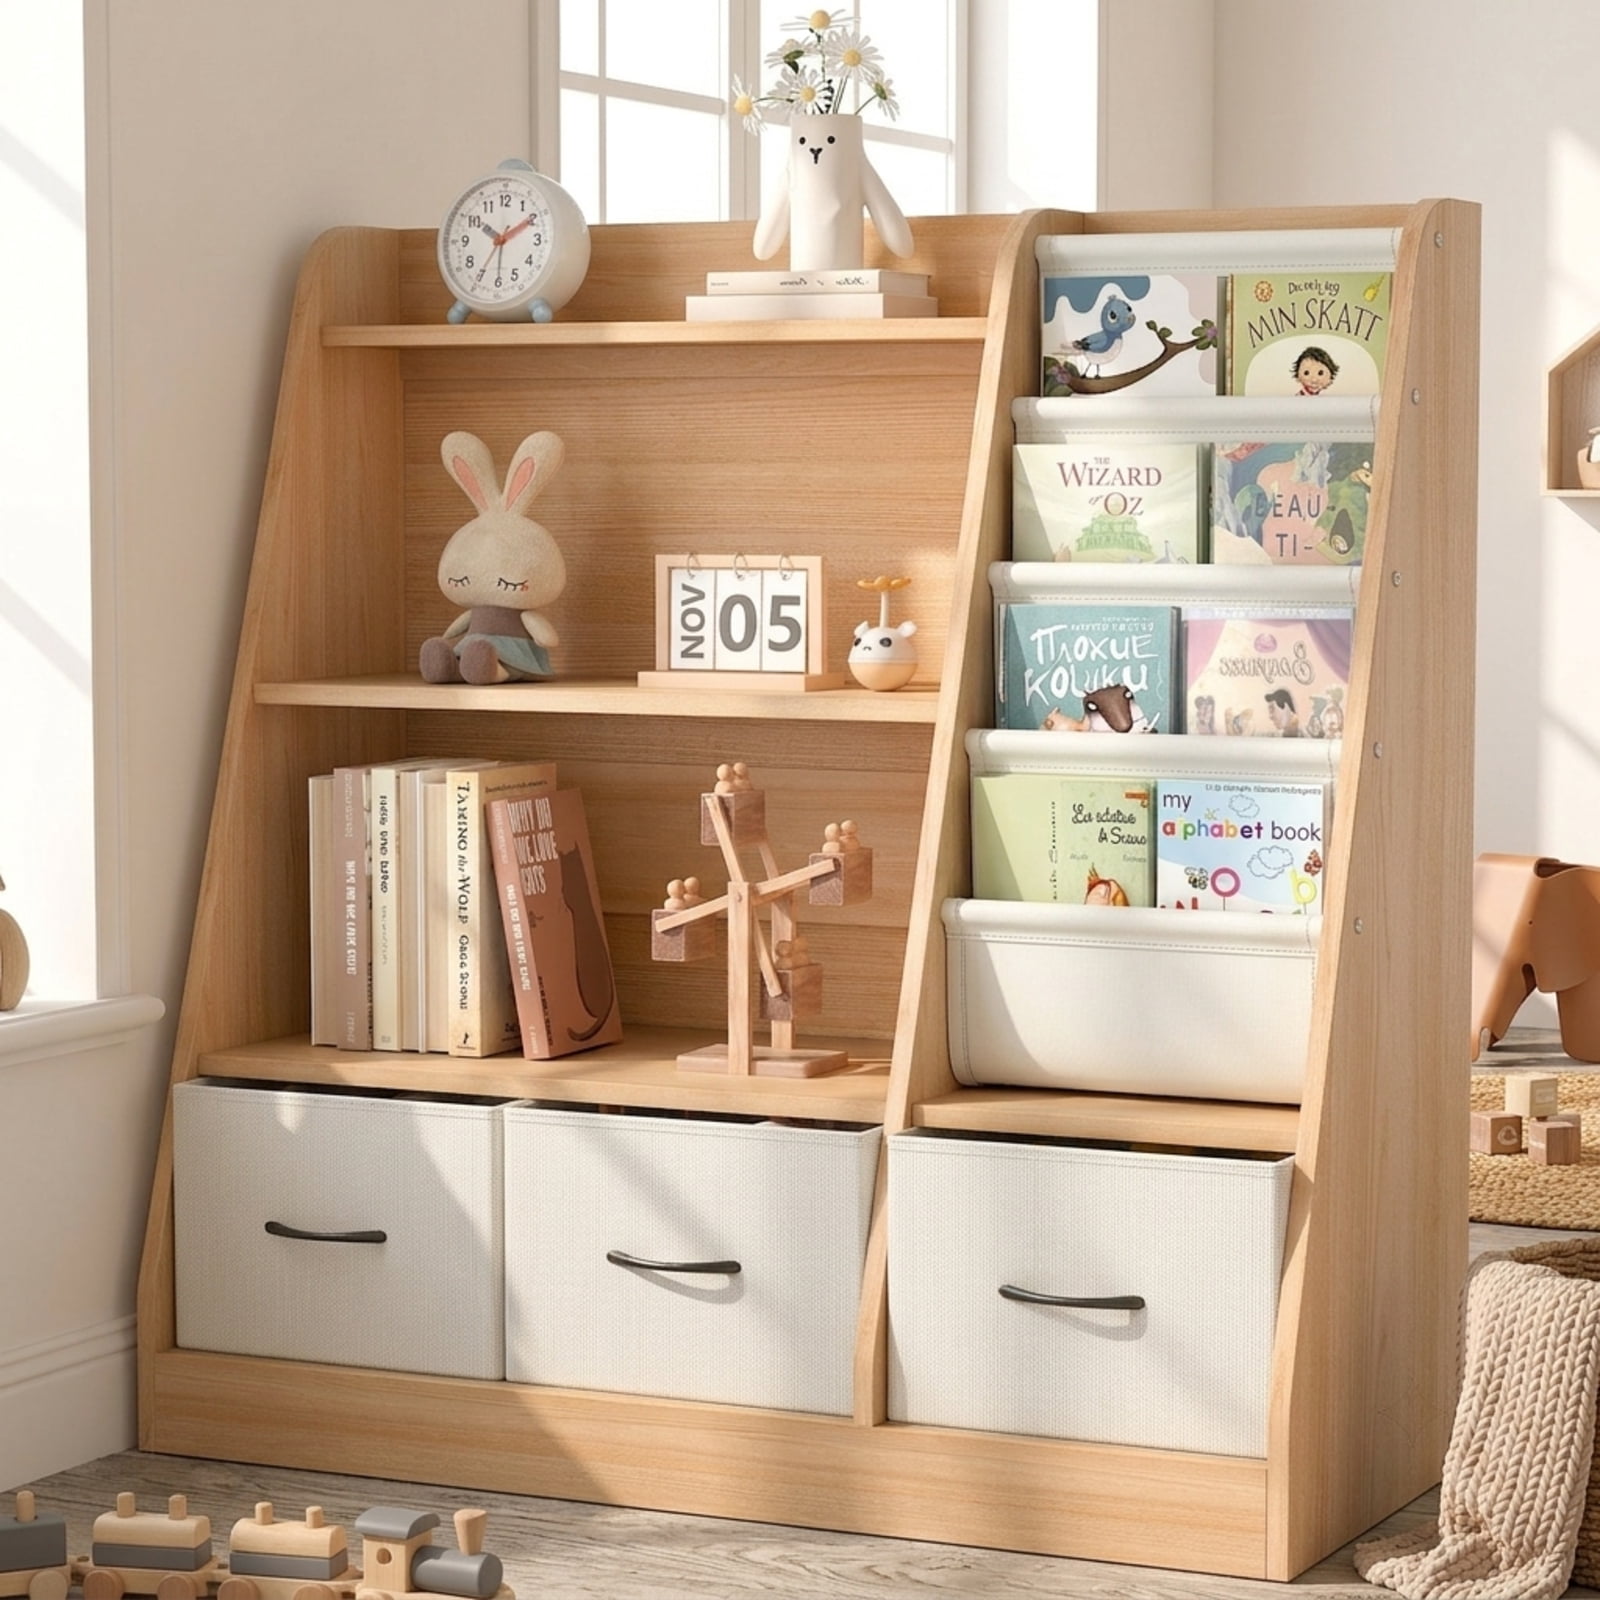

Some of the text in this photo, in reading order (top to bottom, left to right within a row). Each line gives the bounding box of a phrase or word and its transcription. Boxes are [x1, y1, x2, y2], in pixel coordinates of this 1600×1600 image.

[483, 201, 494, 213] 11
[500, 194, 512, 208] 12
[461, 235, 470, 247] 9
[533, 233, 542, 246] 3
[465, 255, 475, 268] 8
[525, 254, 533, 266] 4
[510, 268, 519, 281] 5
[494, 277, 503, 288] 6
[1247, 297, 1383, 349] MIN SKATT
[1056, 462, 1162, 488] WIZARD
[680, 583, 706, 659] NOV
[1163, 794, 1192, 812] my
[1271, 821, 1322, 841] book
